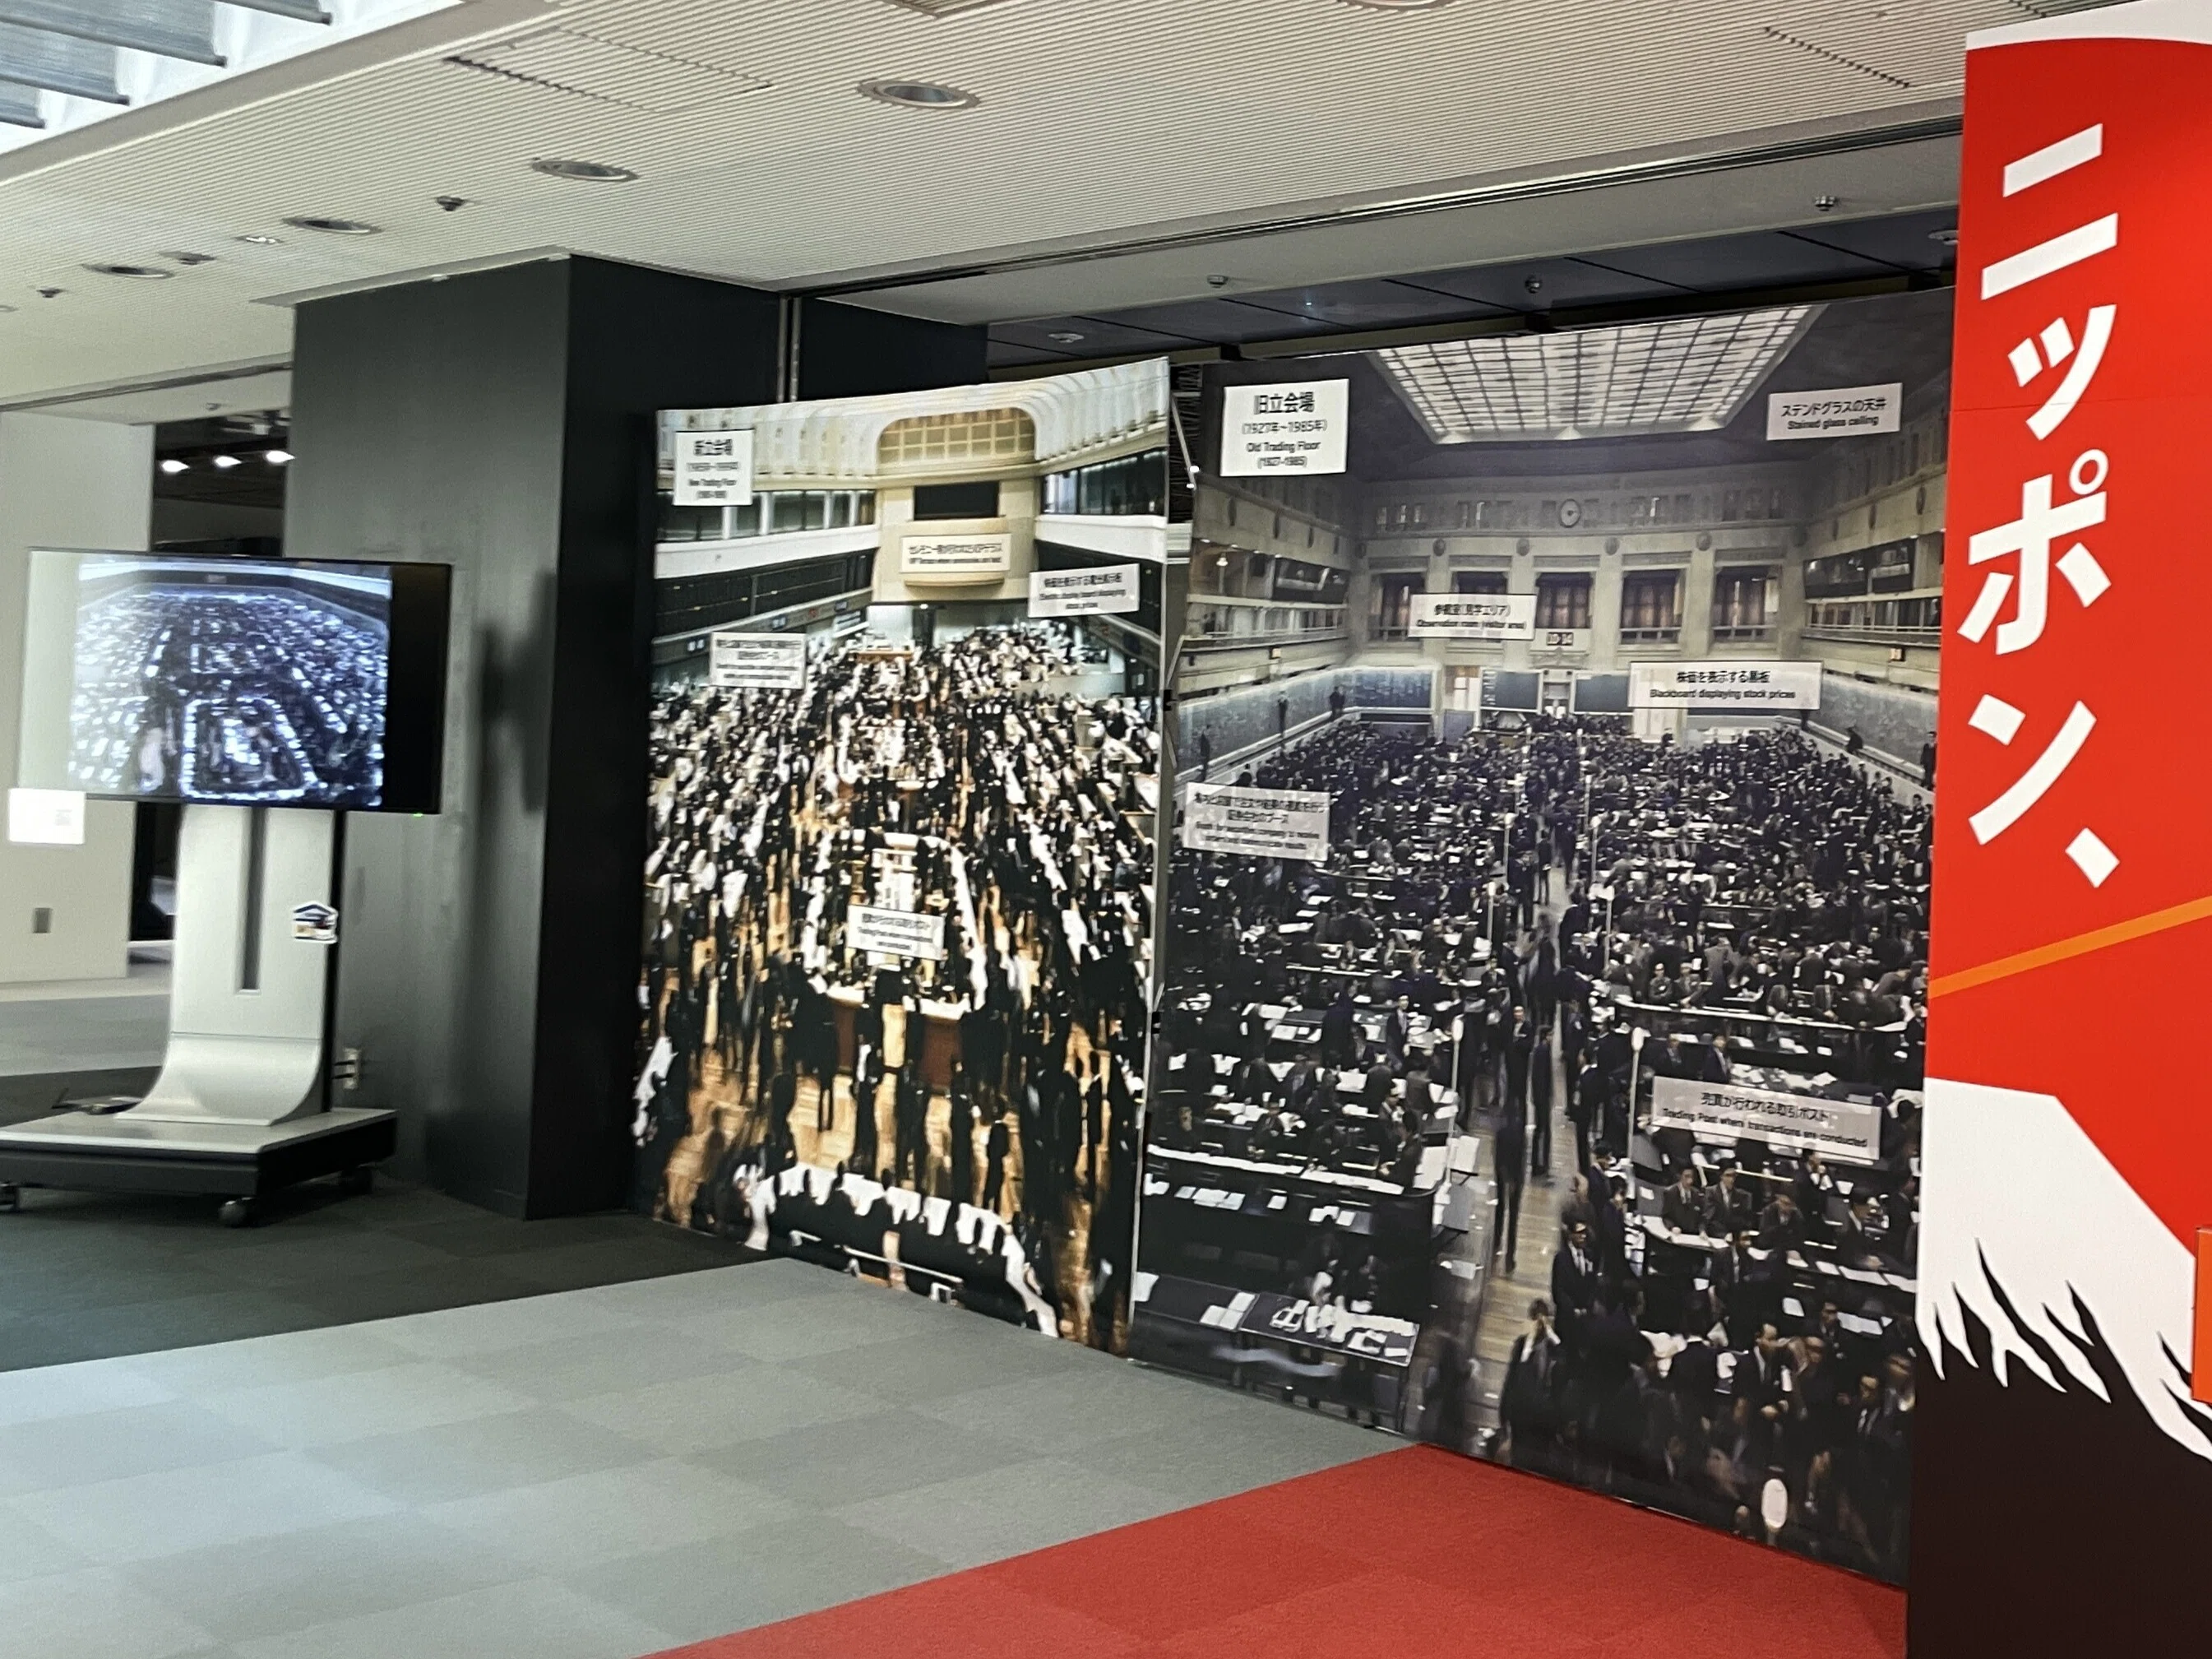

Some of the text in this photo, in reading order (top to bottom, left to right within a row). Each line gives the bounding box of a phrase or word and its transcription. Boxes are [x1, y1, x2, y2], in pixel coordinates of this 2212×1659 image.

[1254, 391, 1315, 415] 旧立会場
[1781, 396, 1887, 417] ステンドグラスの天井
[1822, 418, 1846, 429] glass
[1264, 441, 1295, 453] Trading
[1298, 440, 1321, 452] Floor
[1663, 1107, 1696, 1122] Trading
[1698, 1112, 1718, 1124] Post
